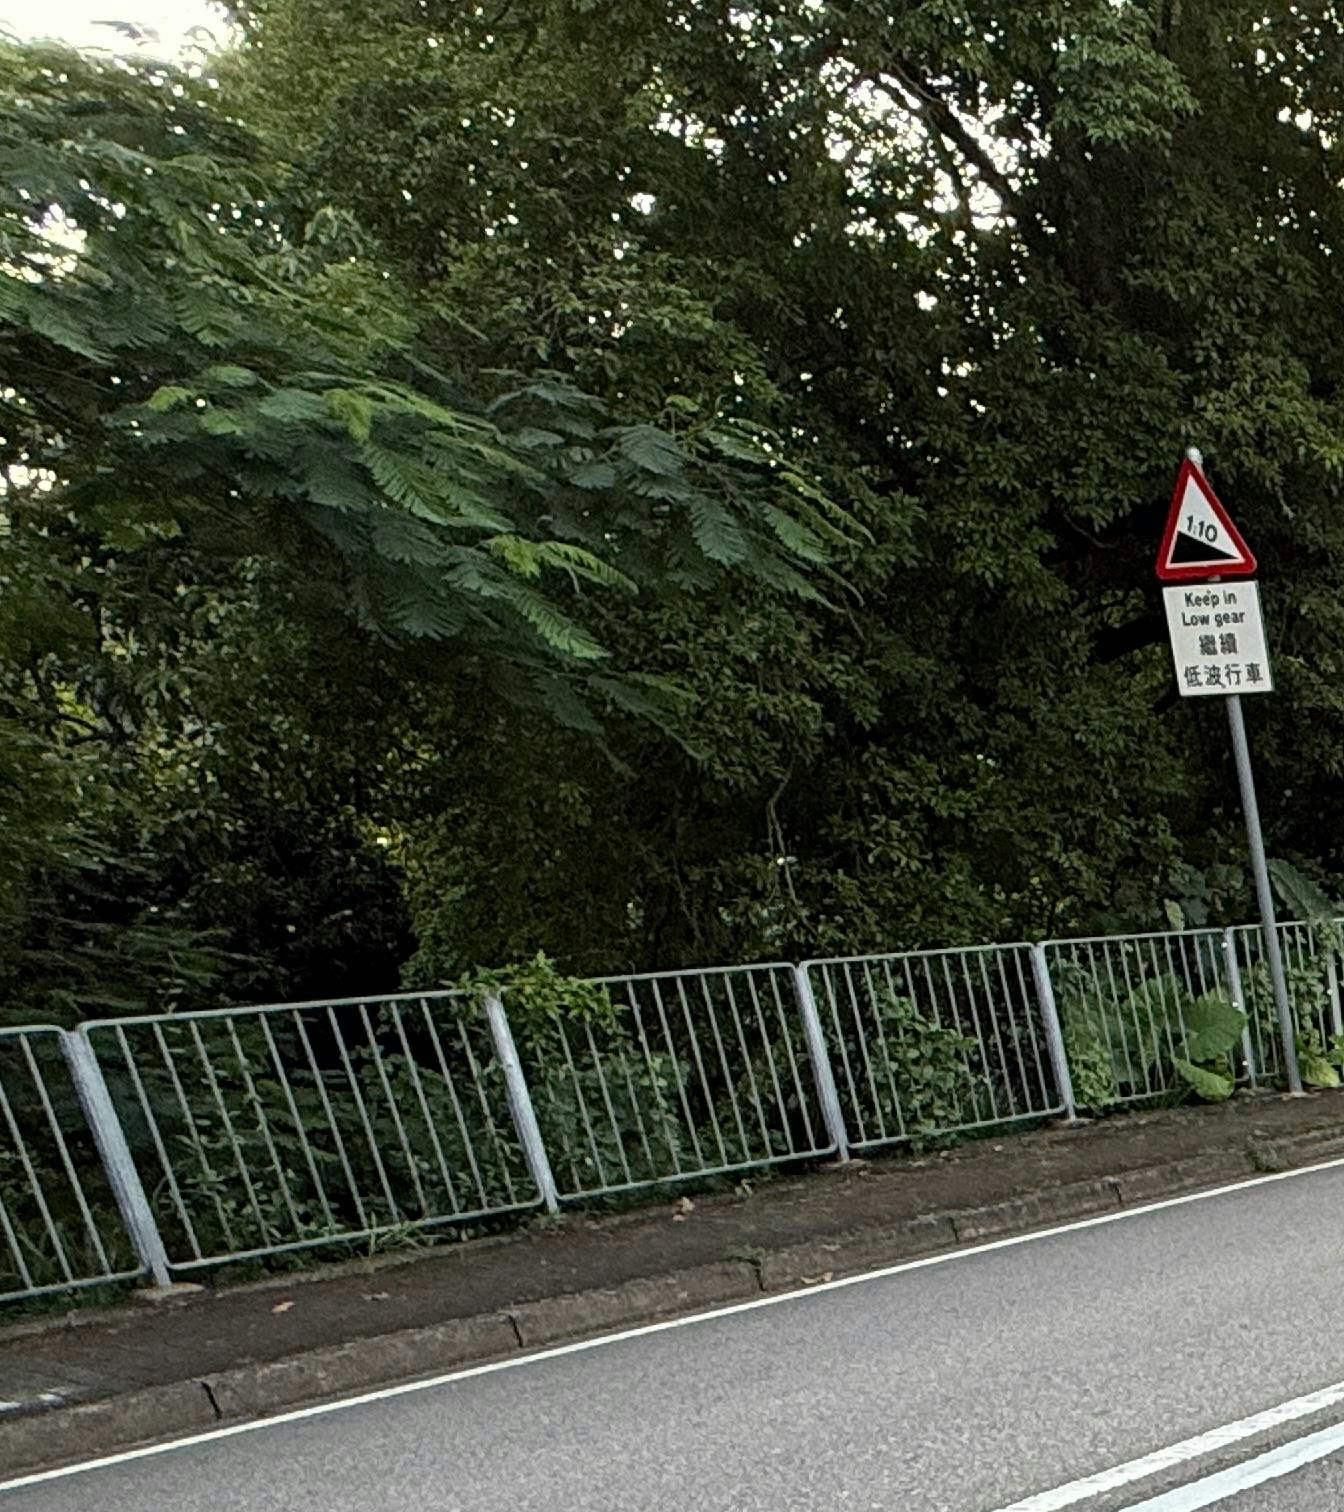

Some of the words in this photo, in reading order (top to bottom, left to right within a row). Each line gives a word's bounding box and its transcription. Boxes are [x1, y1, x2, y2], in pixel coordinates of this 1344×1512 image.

[1187, 515, 1217, 543] 1:10
[1184, 591, 1220, 608] Keep
[1222, 589, 1238, 605] in
[1181, 611, 1210, 626] Low
[1214, 611, 1245, 628] gear
